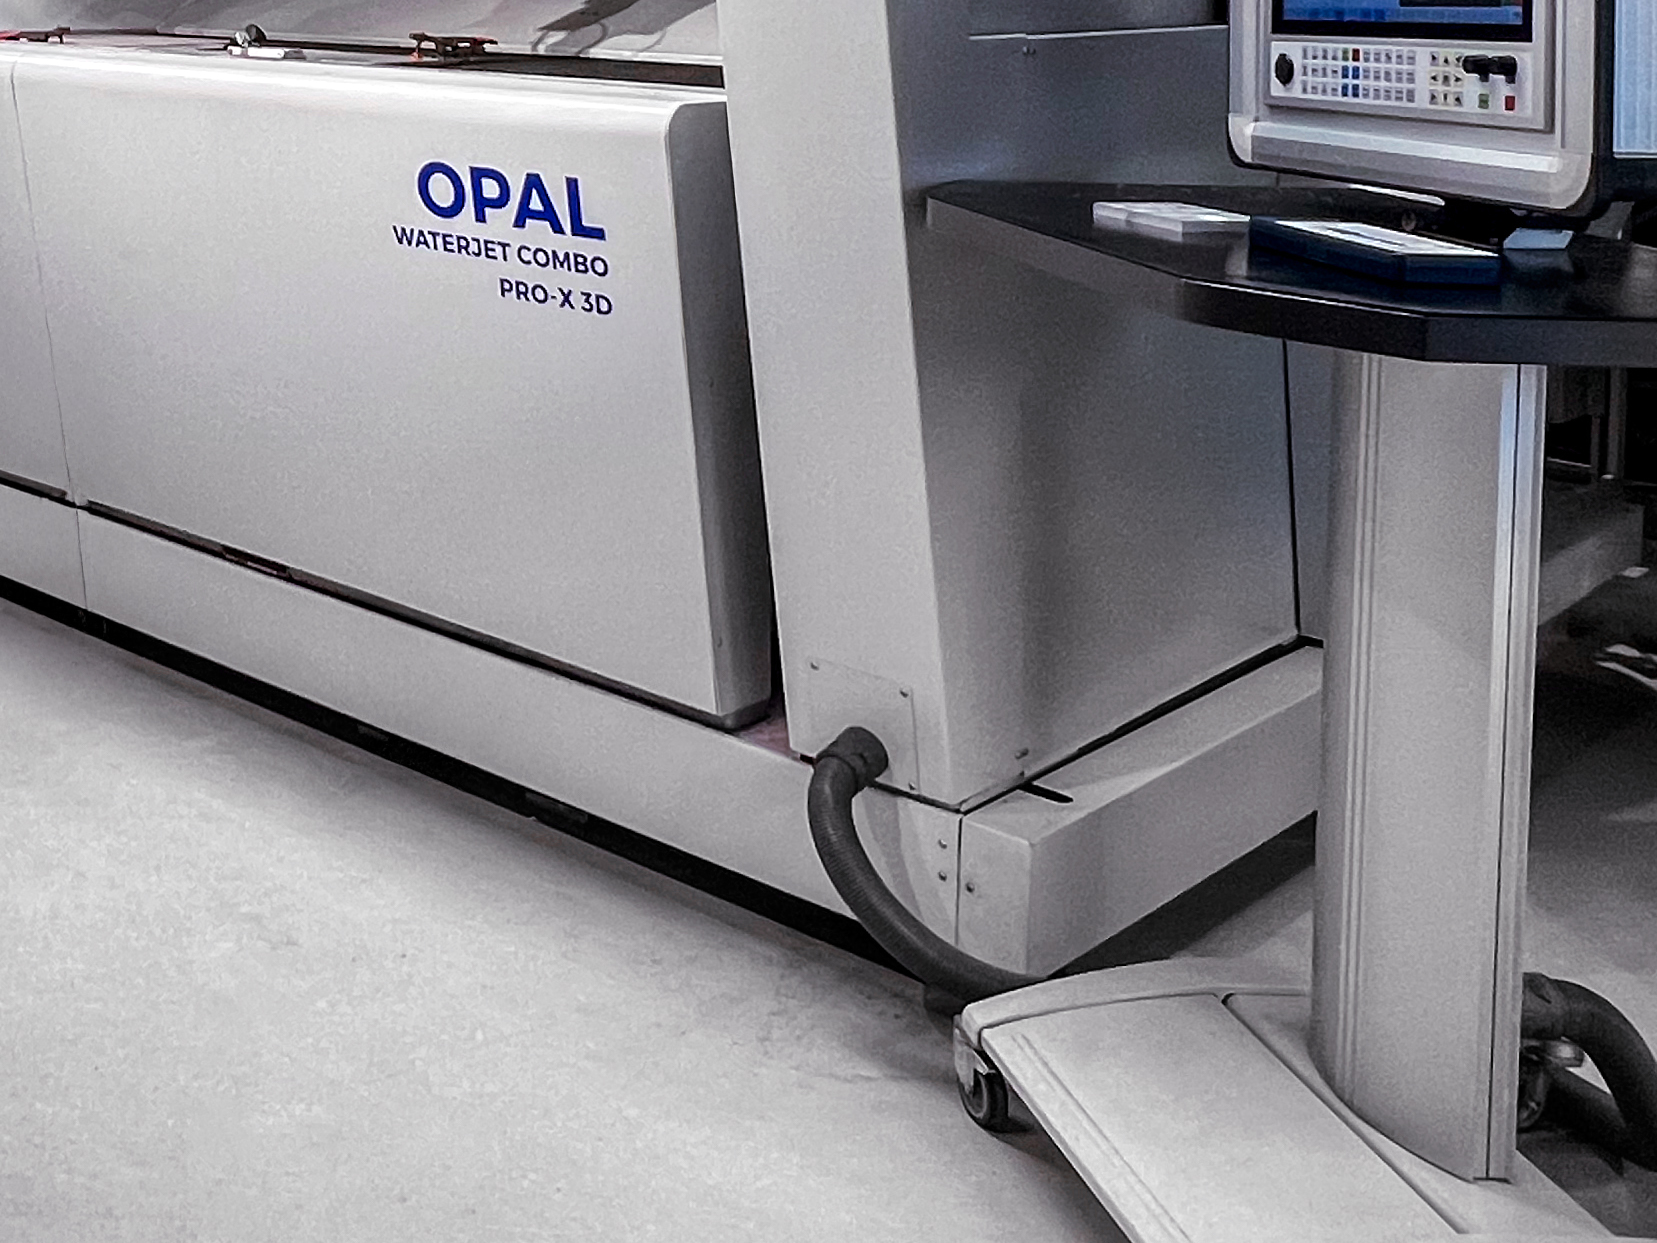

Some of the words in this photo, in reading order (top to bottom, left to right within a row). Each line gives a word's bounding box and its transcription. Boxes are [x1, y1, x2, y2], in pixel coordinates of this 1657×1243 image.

[417, 161, 607, 241] OPAL
[392, 224, 511, 262] WATERJET
[516, 244, 609, 277] COMBO
[499, 277, 575, 310] PRO-X
[580, 291, 613, 316] 3D
